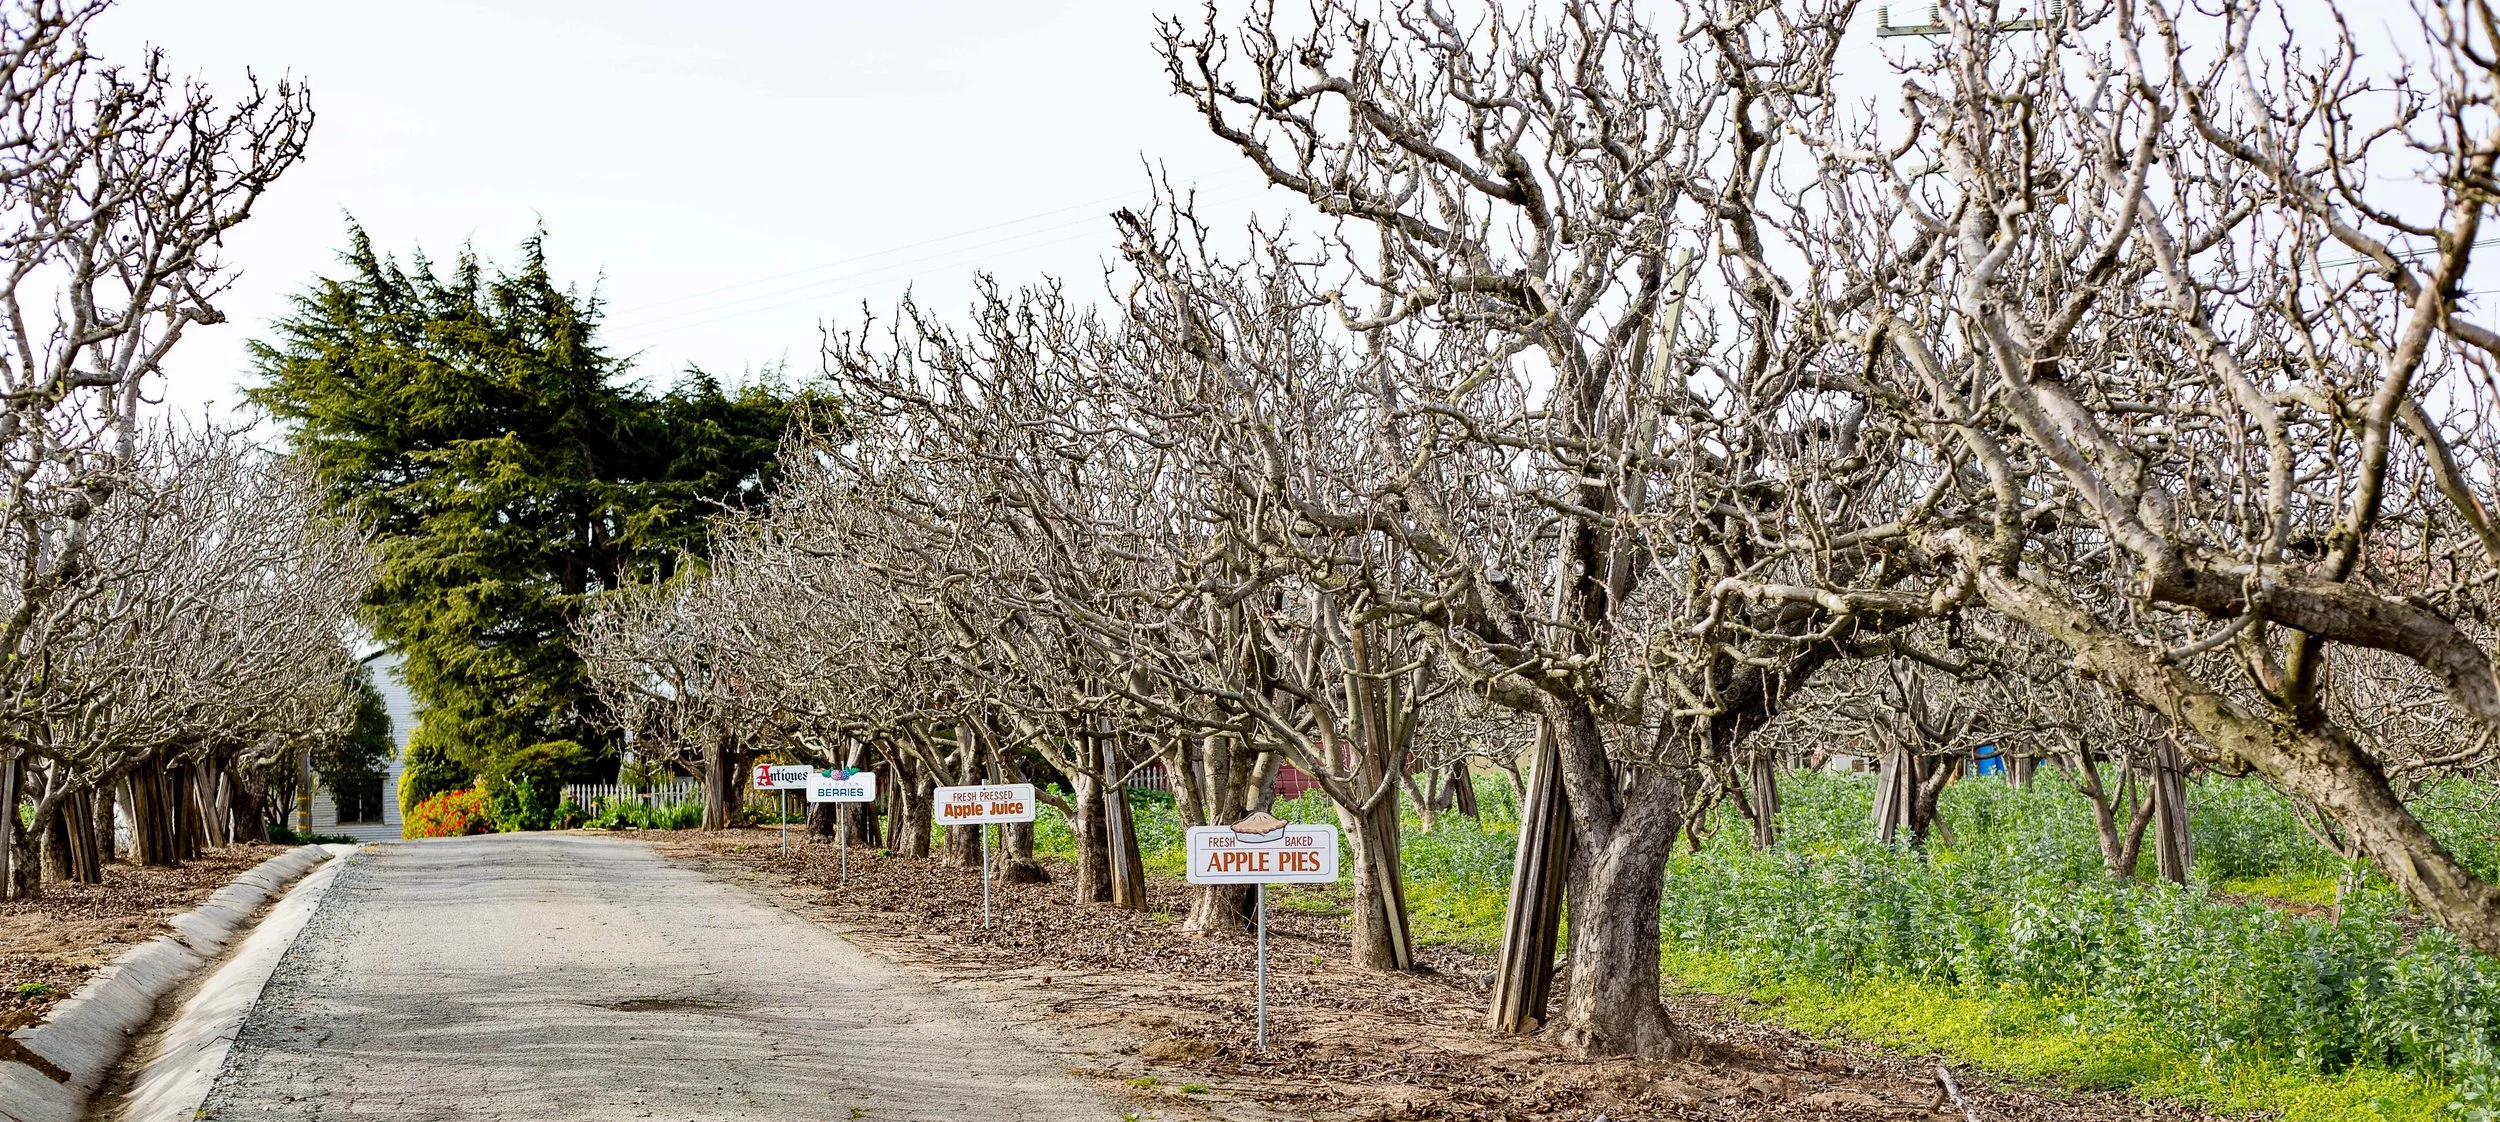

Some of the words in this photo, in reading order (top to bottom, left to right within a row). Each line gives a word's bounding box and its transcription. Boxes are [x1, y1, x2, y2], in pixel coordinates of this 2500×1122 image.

[756, 765, 809, 786] Antiques
[818, 788, 864, 797] BERRIES
[953, 792, 977, 802] FRESH
[980, 791, 1013, 800] PRESSED
[944, 802, 983, 818] Apple
[990, 801, 1023, 815] Juice
[1209, 837, 1235, 847] FRESH
[1285, 836, 1313, 846] BAKED
[1207, 851, 1269, 872] APPLE
[1279, 851, 1320, 871] PIES
